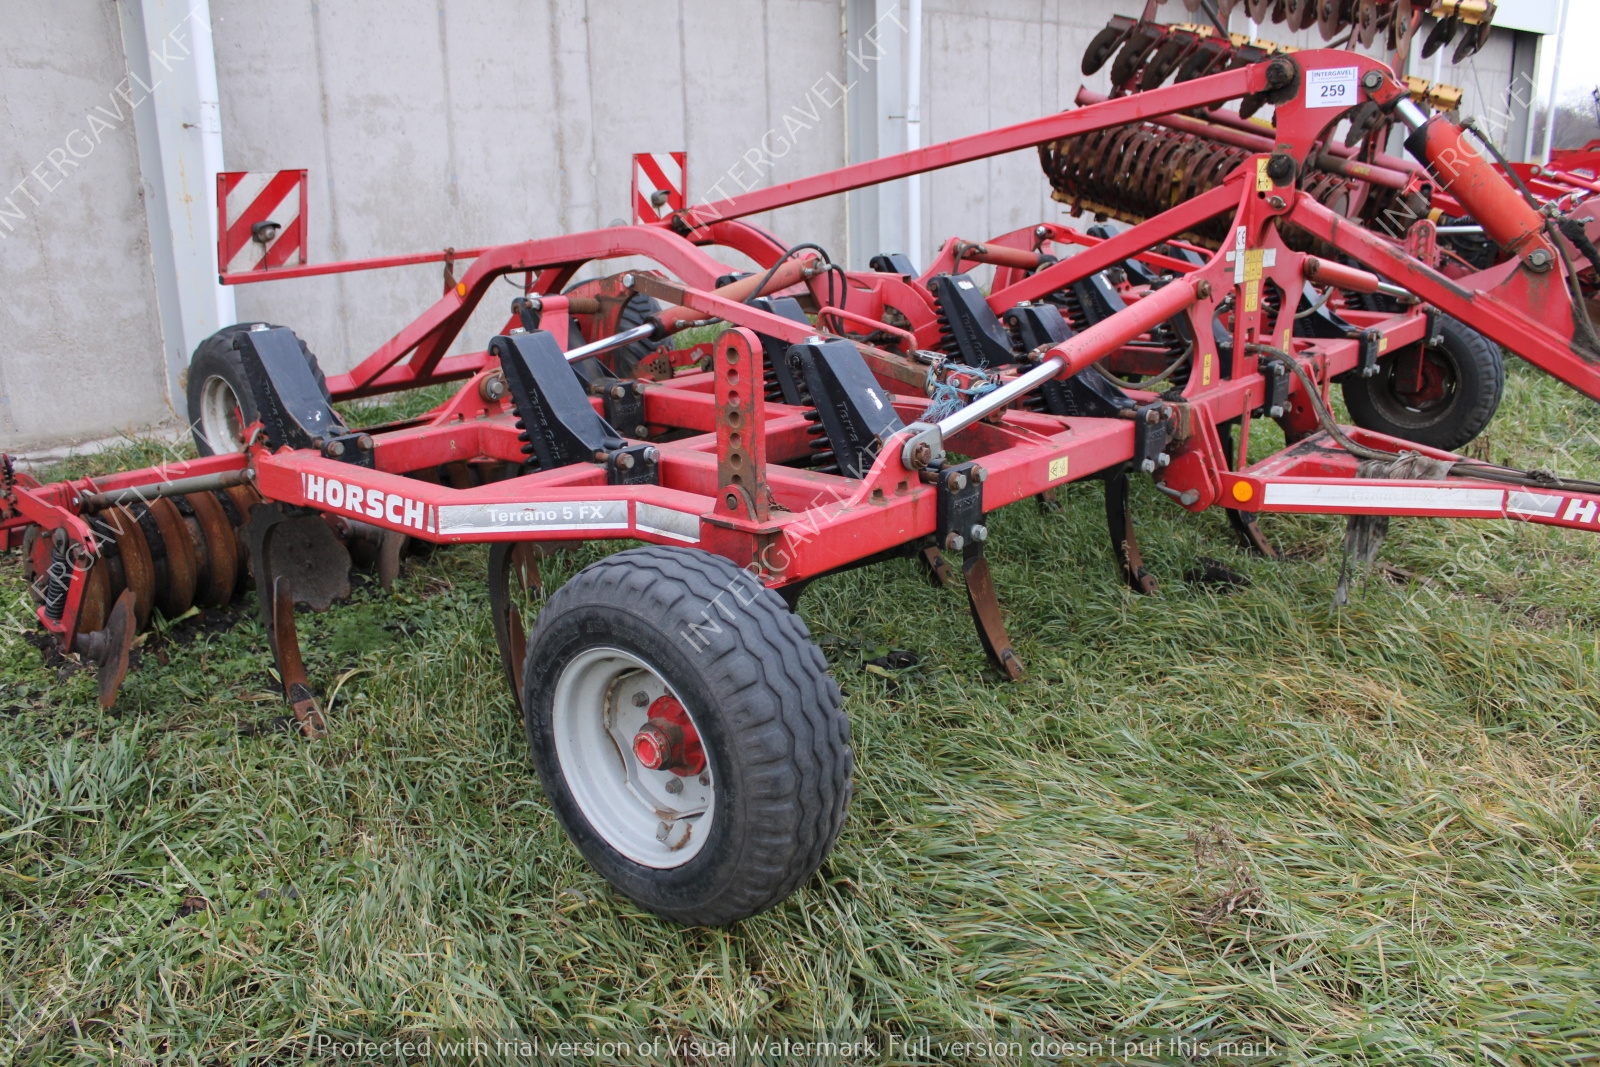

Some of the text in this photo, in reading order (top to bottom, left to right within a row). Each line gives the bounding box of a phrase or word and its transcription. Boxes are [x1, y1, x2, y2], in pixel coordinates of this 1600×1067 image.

[1320, 84, 1346, 98] 259
[529, 388, 548, 426] Terra
[836, 401, 859, 442] Terra
[307, 474, 425, 530] HORSCH
[487, 505, 605, 523] Terrano 5 FX
